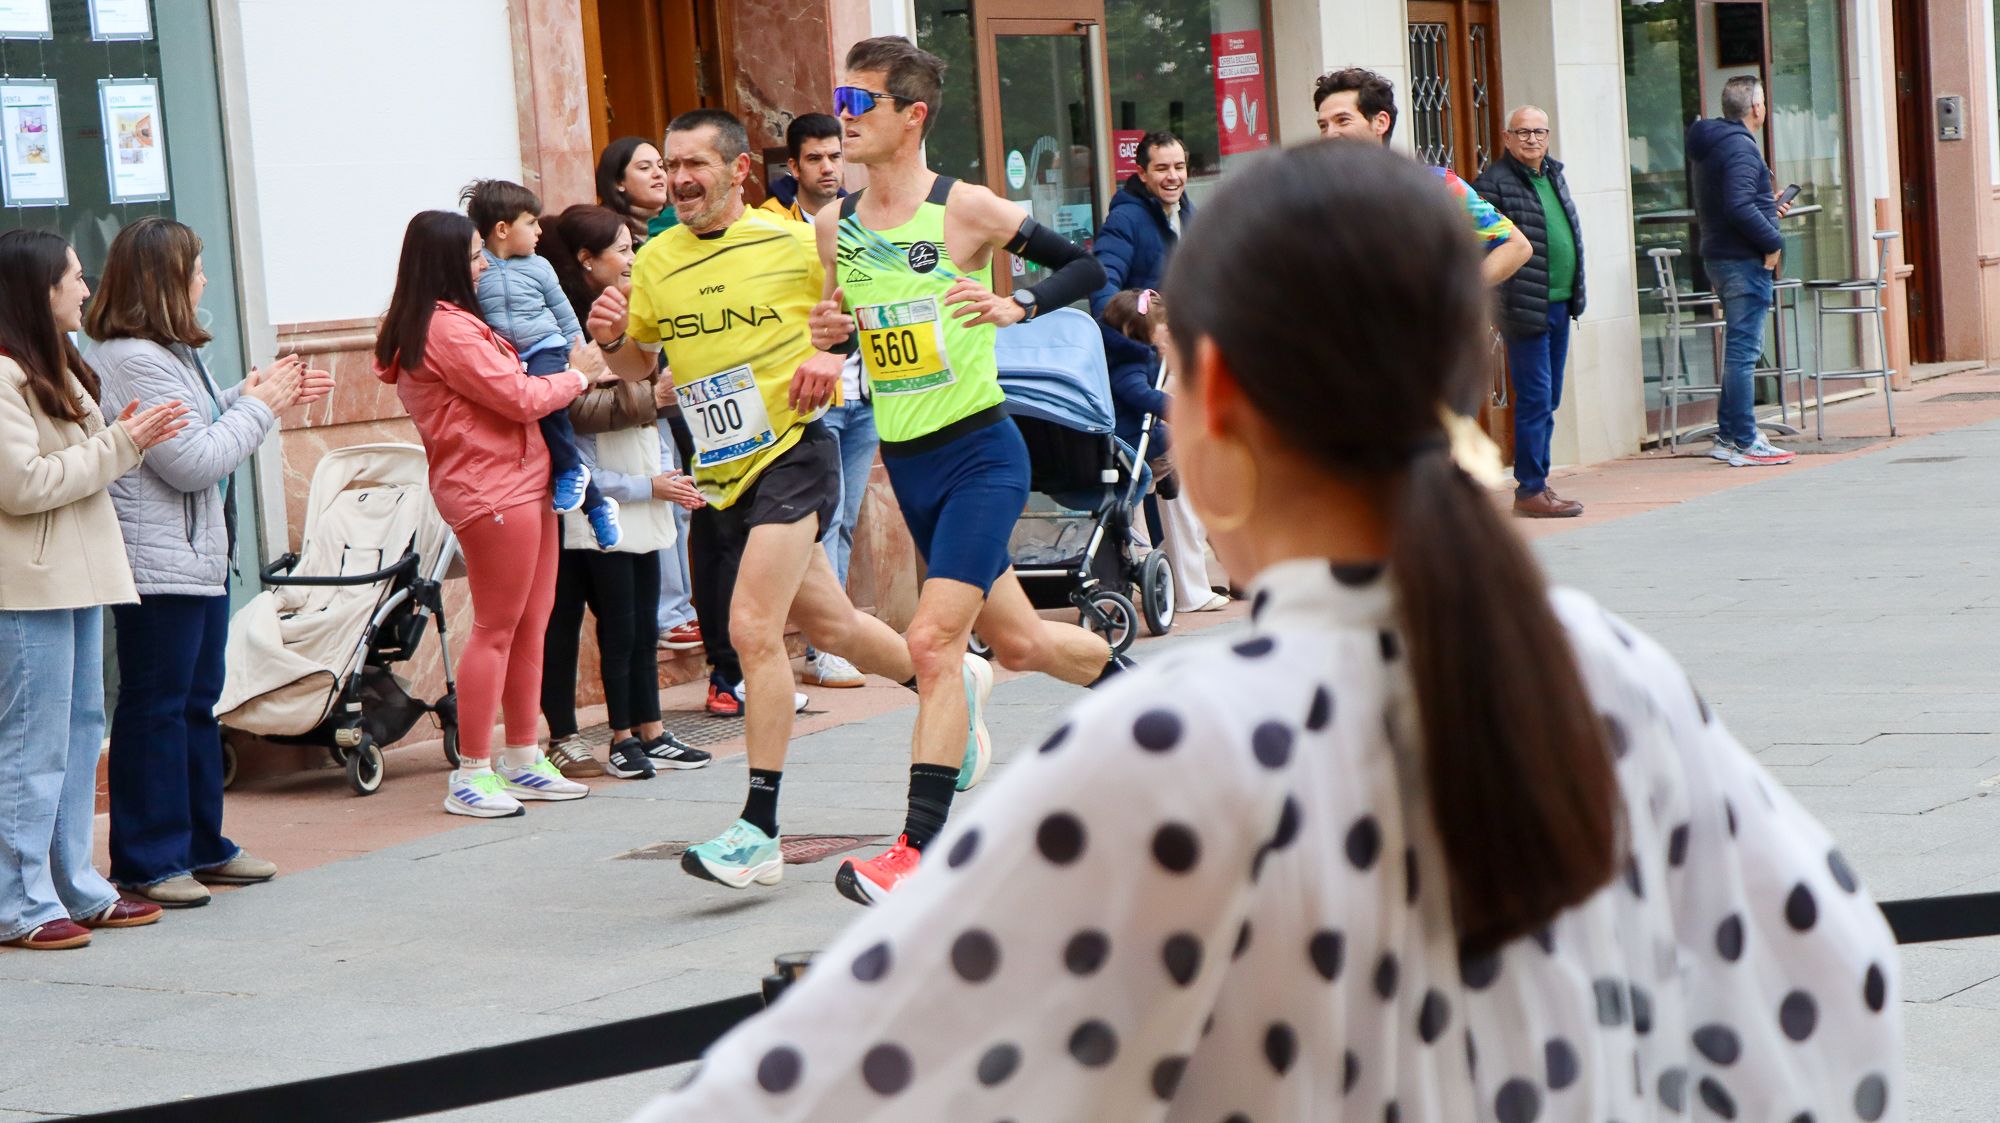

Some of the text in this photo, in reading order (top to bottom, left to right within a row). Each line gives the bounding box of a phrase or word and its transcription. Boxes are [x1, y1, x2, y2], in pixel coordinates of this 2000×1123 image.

[1119, 142, 1139, 158] GAE
[699, 284, 726, 296] vive
[870, 329, 919, 368] 560
[696, 398, 743, 439] 700
